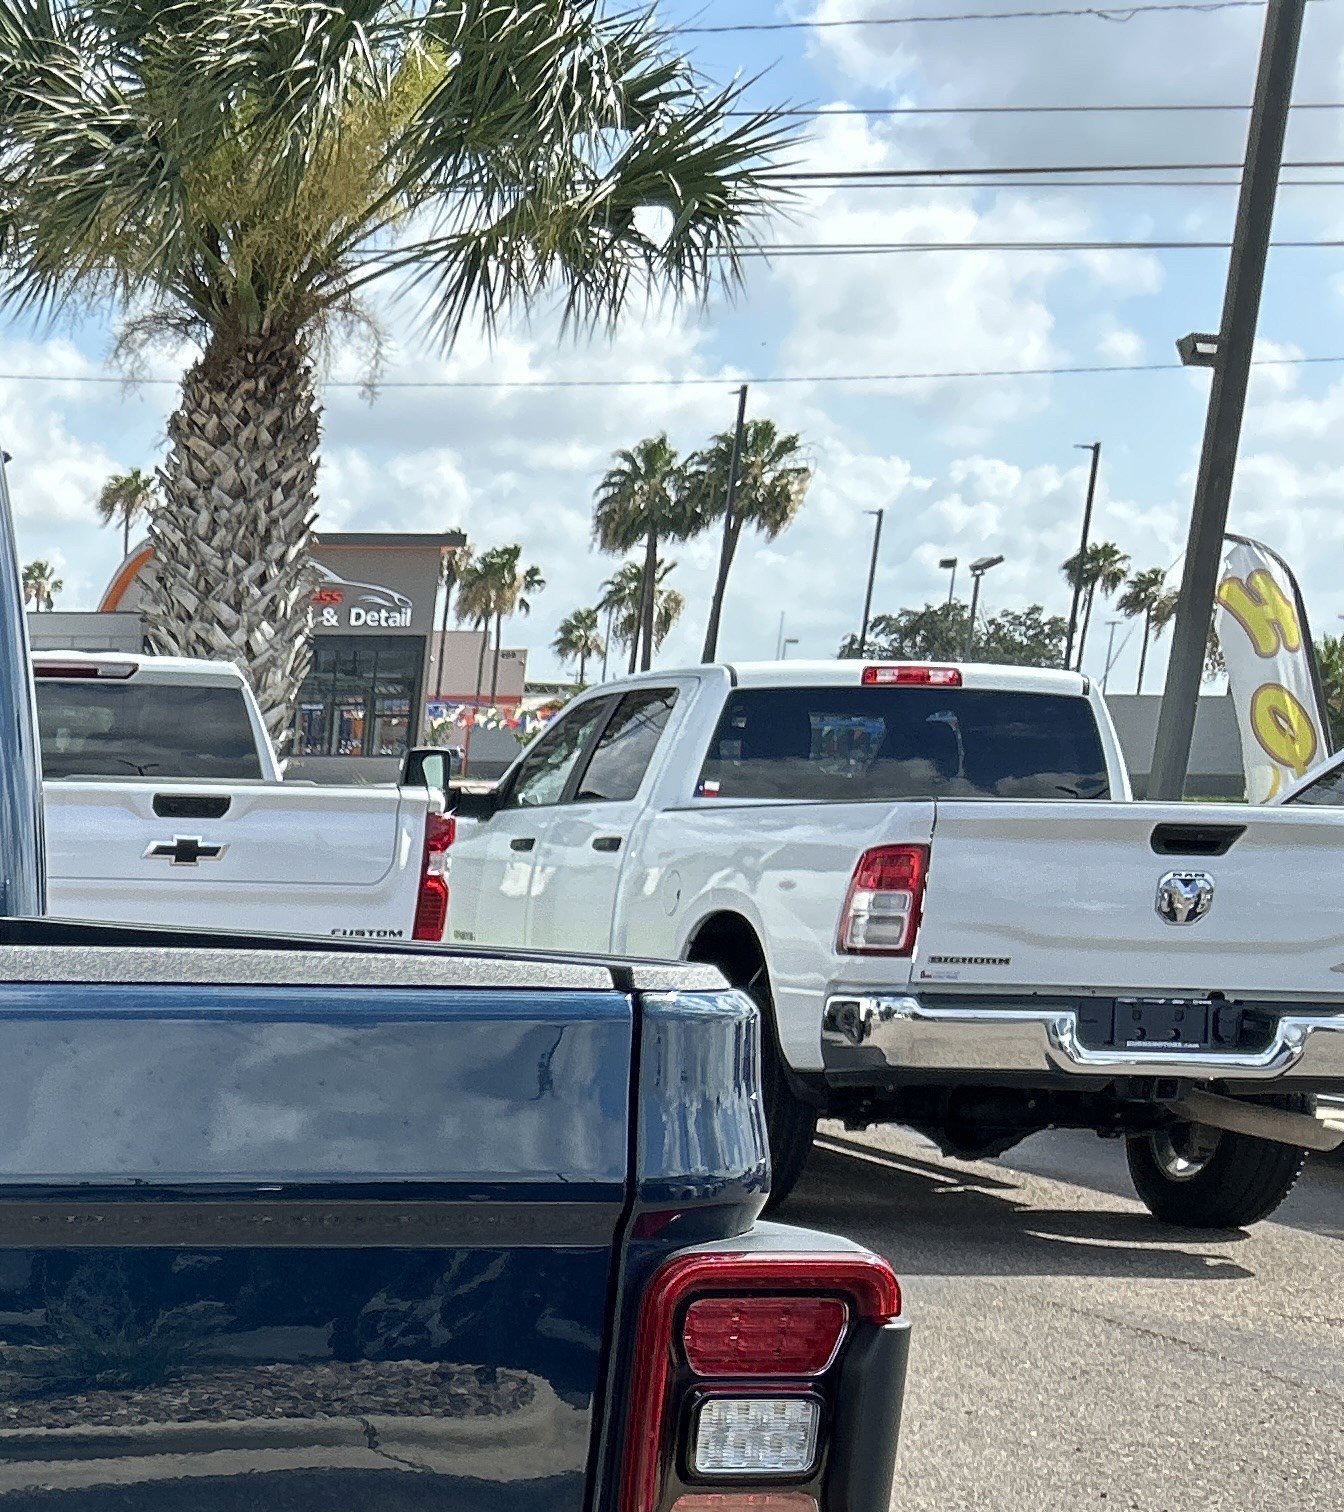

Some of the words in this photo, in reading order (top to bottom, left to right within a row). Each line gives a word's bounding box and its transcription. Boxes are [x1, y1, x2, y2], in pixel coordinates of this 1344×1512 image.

[322, 606, 339, 627] &
[350, 607, 412, 627] Detail
[331, 928, 403, 938] CUSTOM
